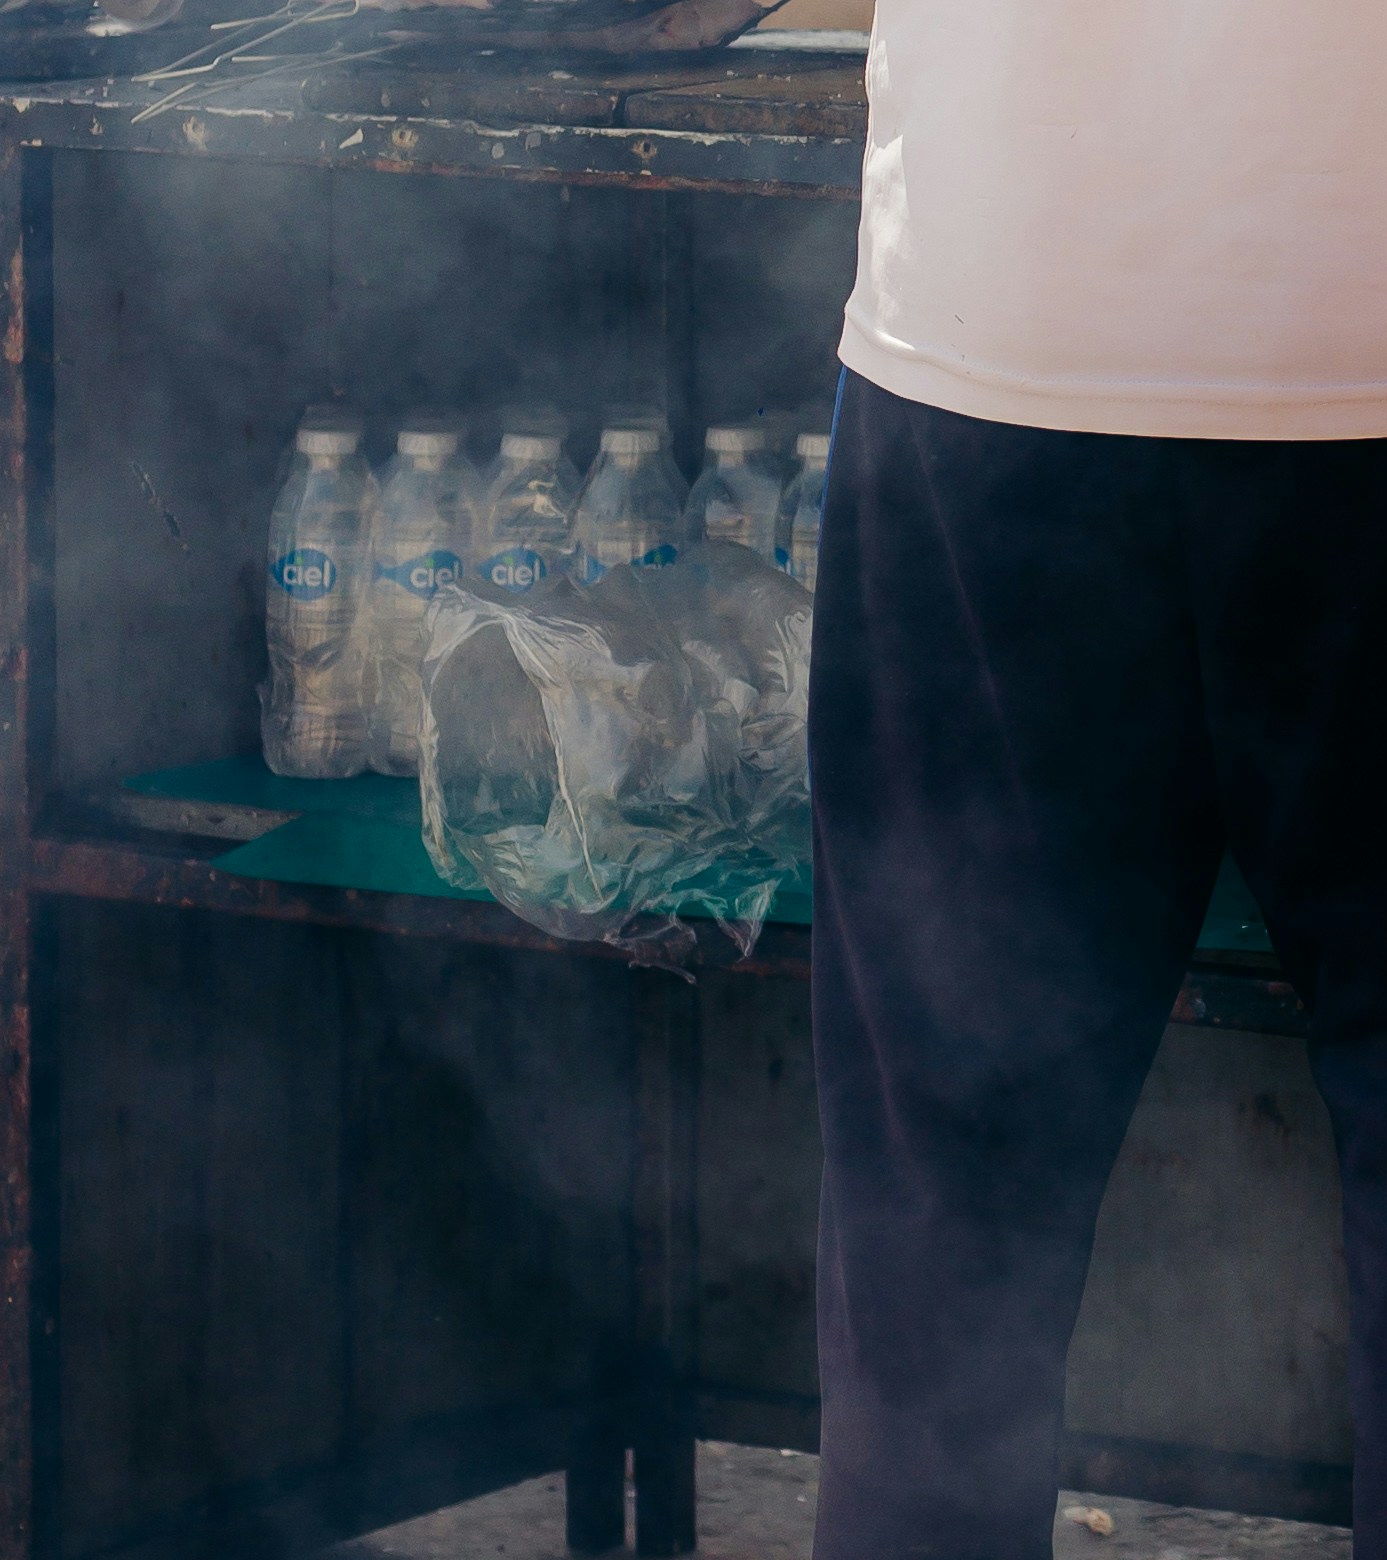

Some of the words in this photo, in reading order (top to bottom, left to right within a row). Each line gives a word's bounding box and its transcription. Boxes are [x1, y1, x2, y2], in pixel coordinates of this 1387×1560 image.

[283, 556, 331, 587] ciel
[410, 557, 460, 588] ciel
[491, 557, 540, 586] ciel
